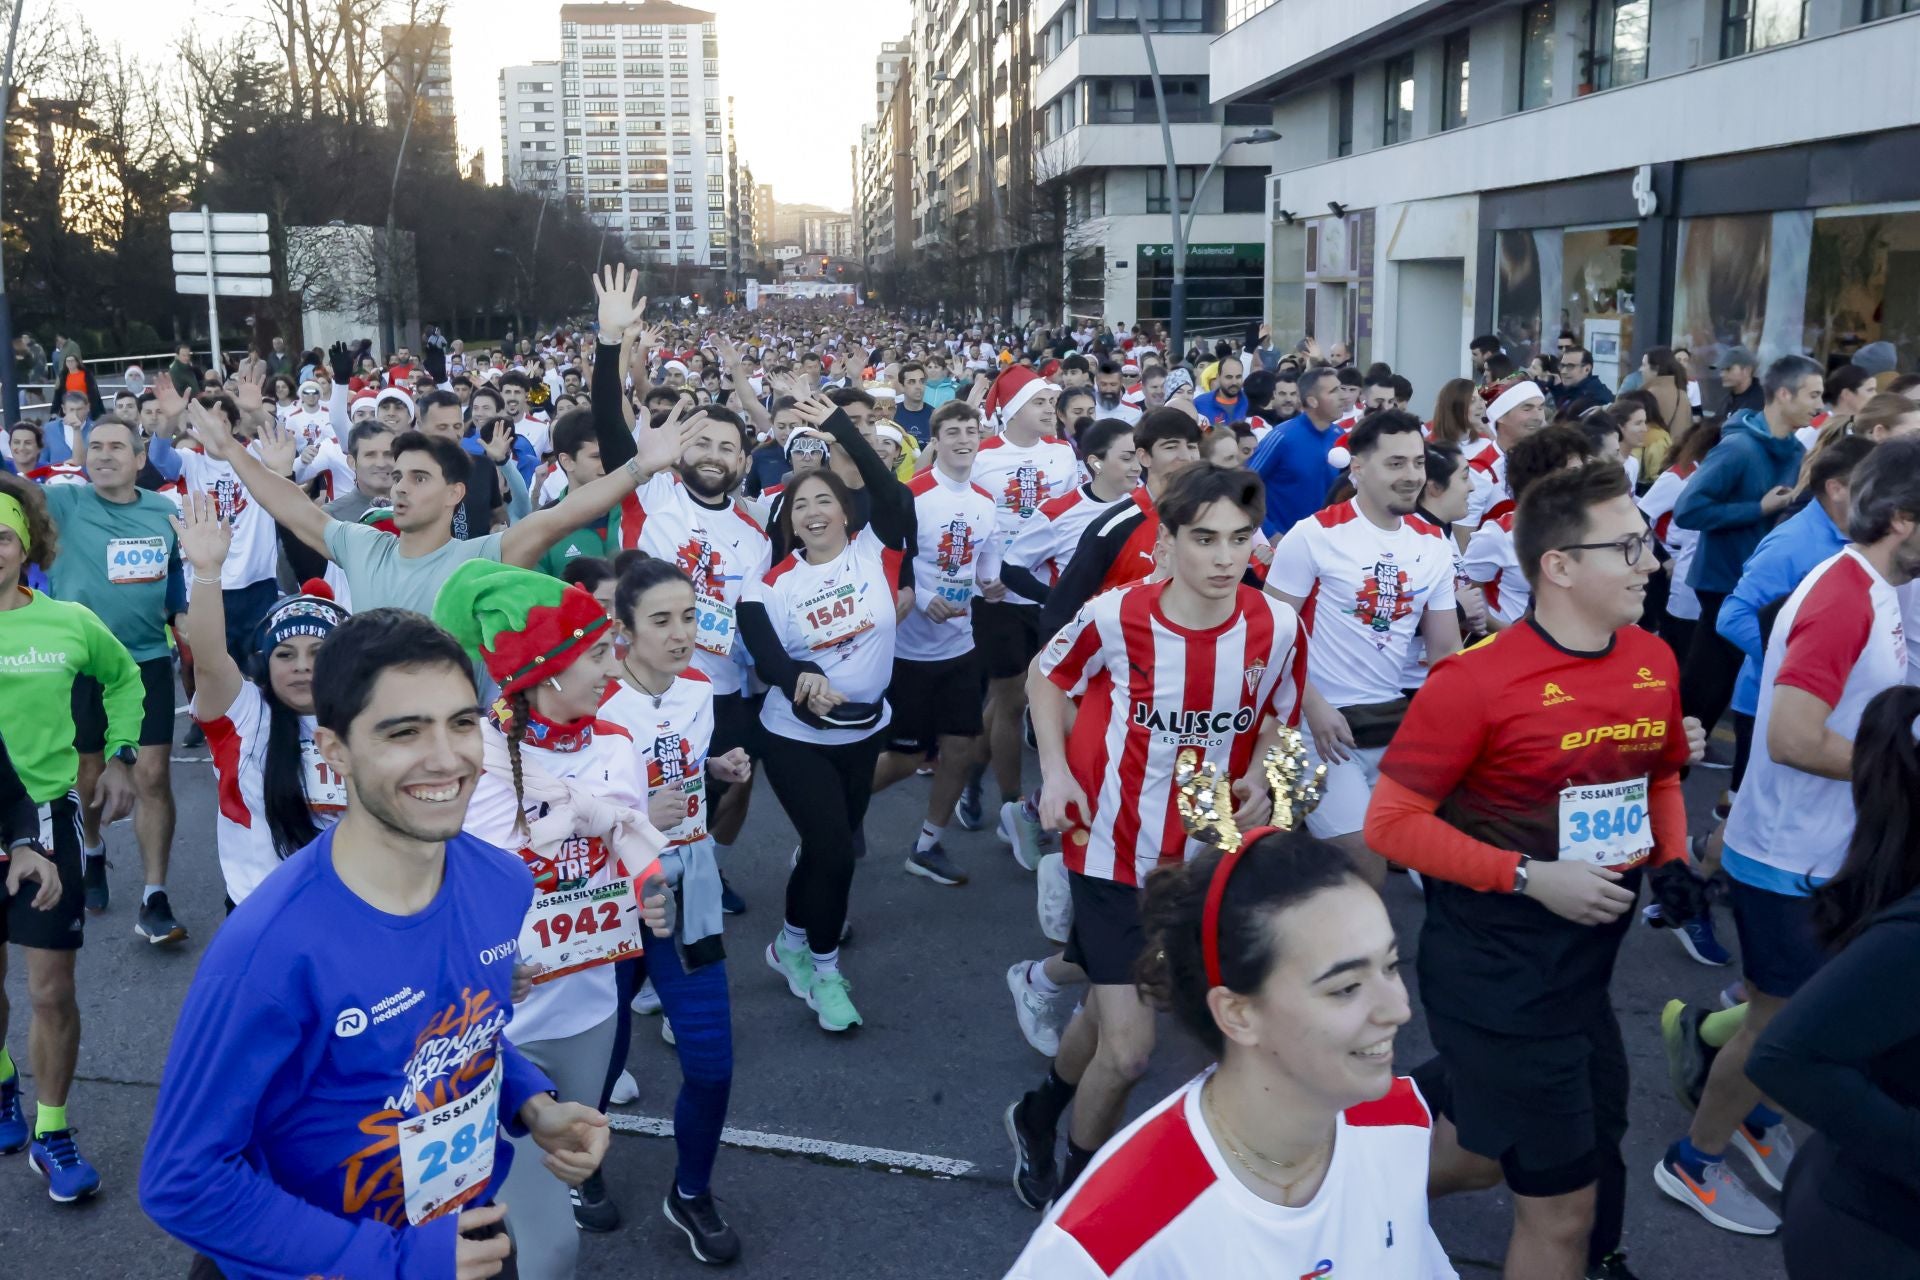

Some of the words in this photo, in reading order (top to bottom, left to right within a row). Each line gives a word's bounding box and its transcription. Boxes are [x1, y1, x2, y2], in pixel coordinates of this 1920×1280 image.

[1191, 245, 1235, 254] Asistencial
[793, 439, 821, 449] 2025
[1021, 481, 1037, 489] SIL
[1020, 498, 1036, 508] TRE
[953, 536, 964, 545] SIL
[114, 548, 164, 566] 4096
[952, 546, 964, 555] VES
[1378, 571, 1398, 586] SAN
[1384, 566, 1398, 576] 55
[812, 595, 825, 604] SAN
[825, 583, 853, 599] SILVESTRE
[1378, 583, 1398, 596] SIL
[1377, 595, 1396, 608] VES
[695, 608, 729, 636] 84
[806, 596, 854, 630] 1547
[1374, 607, 1395, 621] TRE
[1134, 702, 1254, 734] JALISCO
[1163, 736, 1175, 745] ES
[1179, 734, 1223, 746] MÉXICO
[1560, 718, 1666, 750] españa
[665, 736, 680, 751] 55
[659, 748, 682, 763] SAN
[662, 761, 683, 779] SIL
[1580, 790, 1594, 800] 55
[1595, 789, 1613, 800] SAN
[1569, 804, 1643, 842] 3840
[557, 838, 590, 860] VES
[554, 857, 590, 880] TRE
[536, 899, 549, 909] 55
[550, 893, 572, 907] SAN
[573, 880, 627, 900] SILVESTRE
[532, 901, 622, 948] 1942
[480, 938, 517, 965] OYSHO
[370, 986, 413, 1015] nationale
[373, 990, 426, 1025] nederlanden
[432, 1110, 451, 1126] 55
[453, 1095, 479, 1118] SAN
